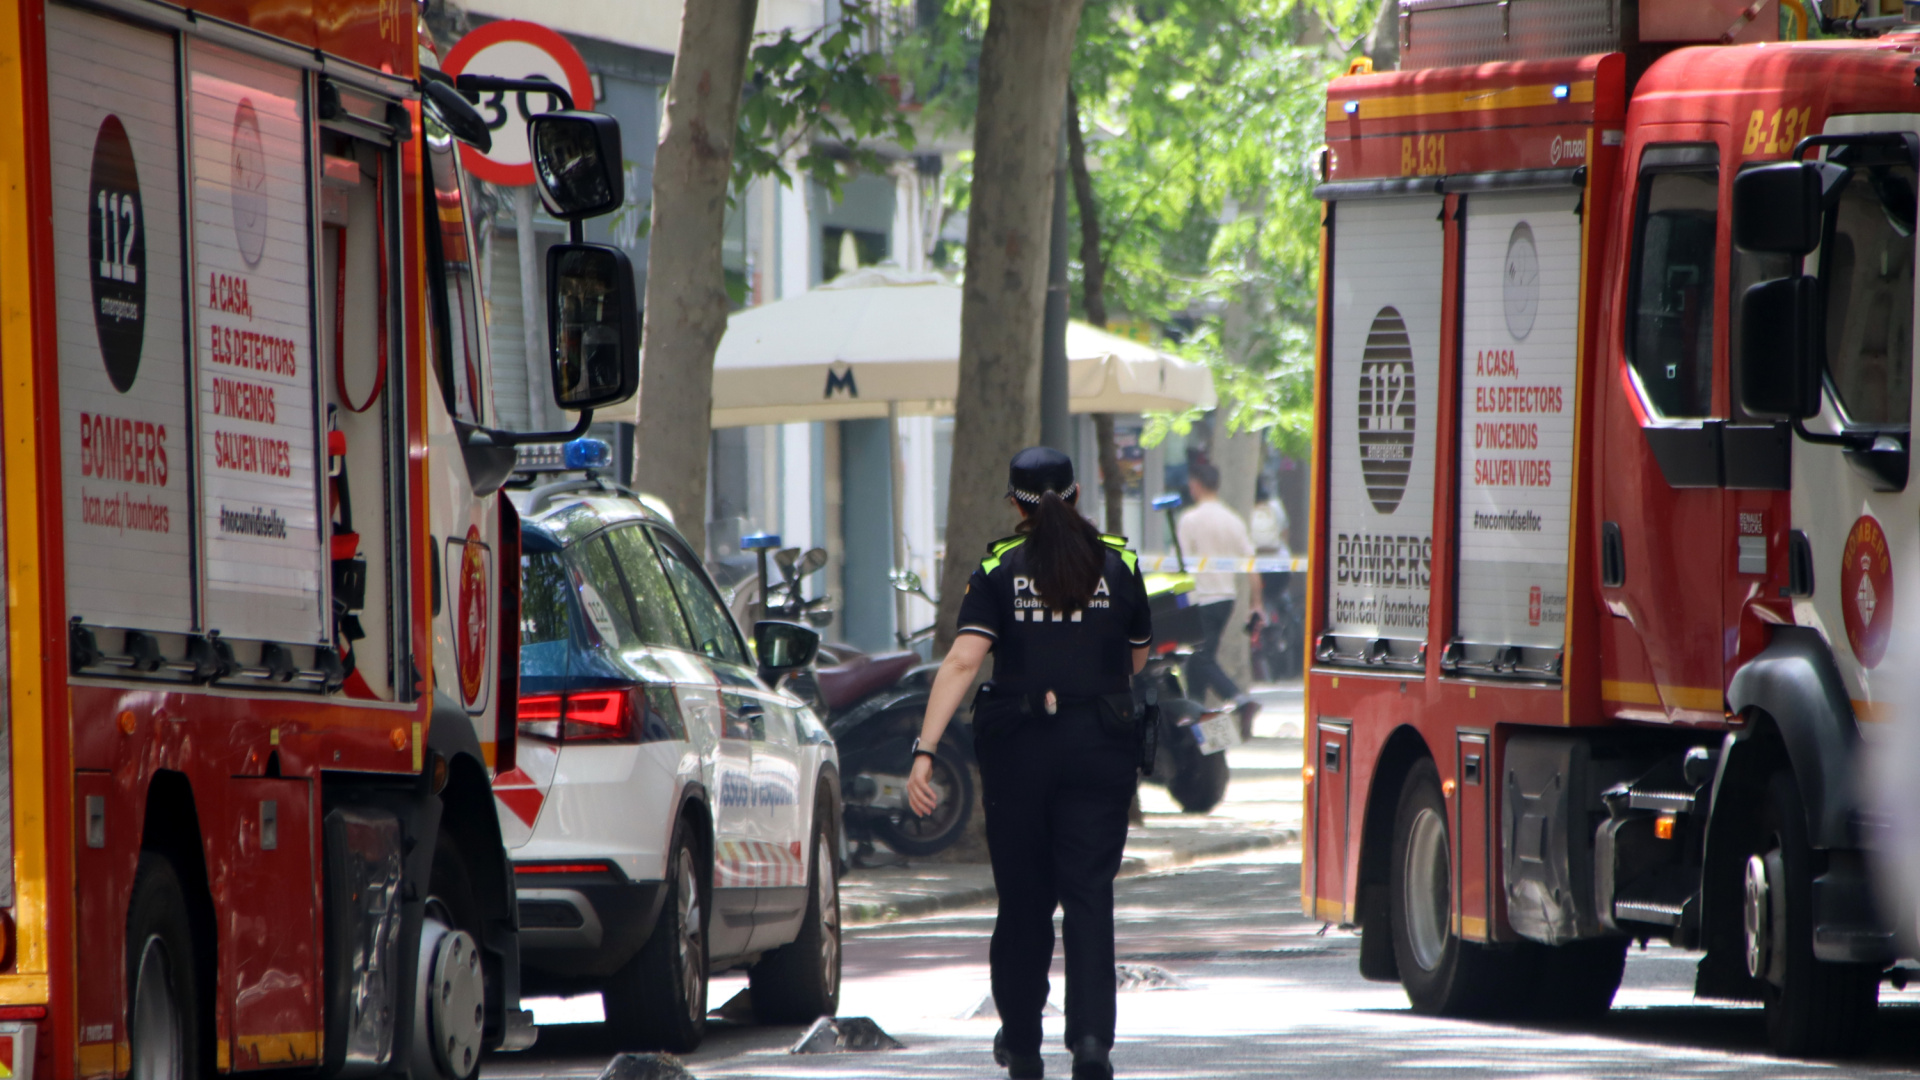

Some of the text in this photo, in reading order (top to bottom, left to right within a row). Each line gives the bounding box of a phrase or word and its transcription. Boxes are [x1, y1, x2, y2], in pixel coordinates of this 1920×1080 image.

[1742, 106, 1811, 155] B-131
[1401, 134, 1447, 177] B-131
[97, 189, 138, 284] 112
[210, 272, 252, 322] A CASA,
[212, 325, 296, 377] ELS DETECTORS
[1477, 350, 1519, 380] A CASA,
[213, 378, 275, 424] D'INCENDIS
[823, 367, 858, 398] M
[1368, 363, 1406, 431] 112
[1476, 386, 1563, 413] ELS DETECTORS
[80, 412, 168, 487] BOMBERS
[215, 430, 291, 478] SALVEN VIDES
[1476, 423, 1538, 450] D'INCENDIS
[1475, 459, 1551, 487] SALVEN VIDES
[82, 487, 169, 536] bcn.cat/bombers
[220, 504, 286, 540] #noconvidiselfoc
[1474, 510, 1541, 532] #noconvidiselfoc
[1739, 512, 1763, 524] RENAULT
[1740, 524, 1763, 534] TRUCKS
[1337, 533, 1432, 590] BOMBERS
[1844, 522, 1889, 574] BOMBERS
